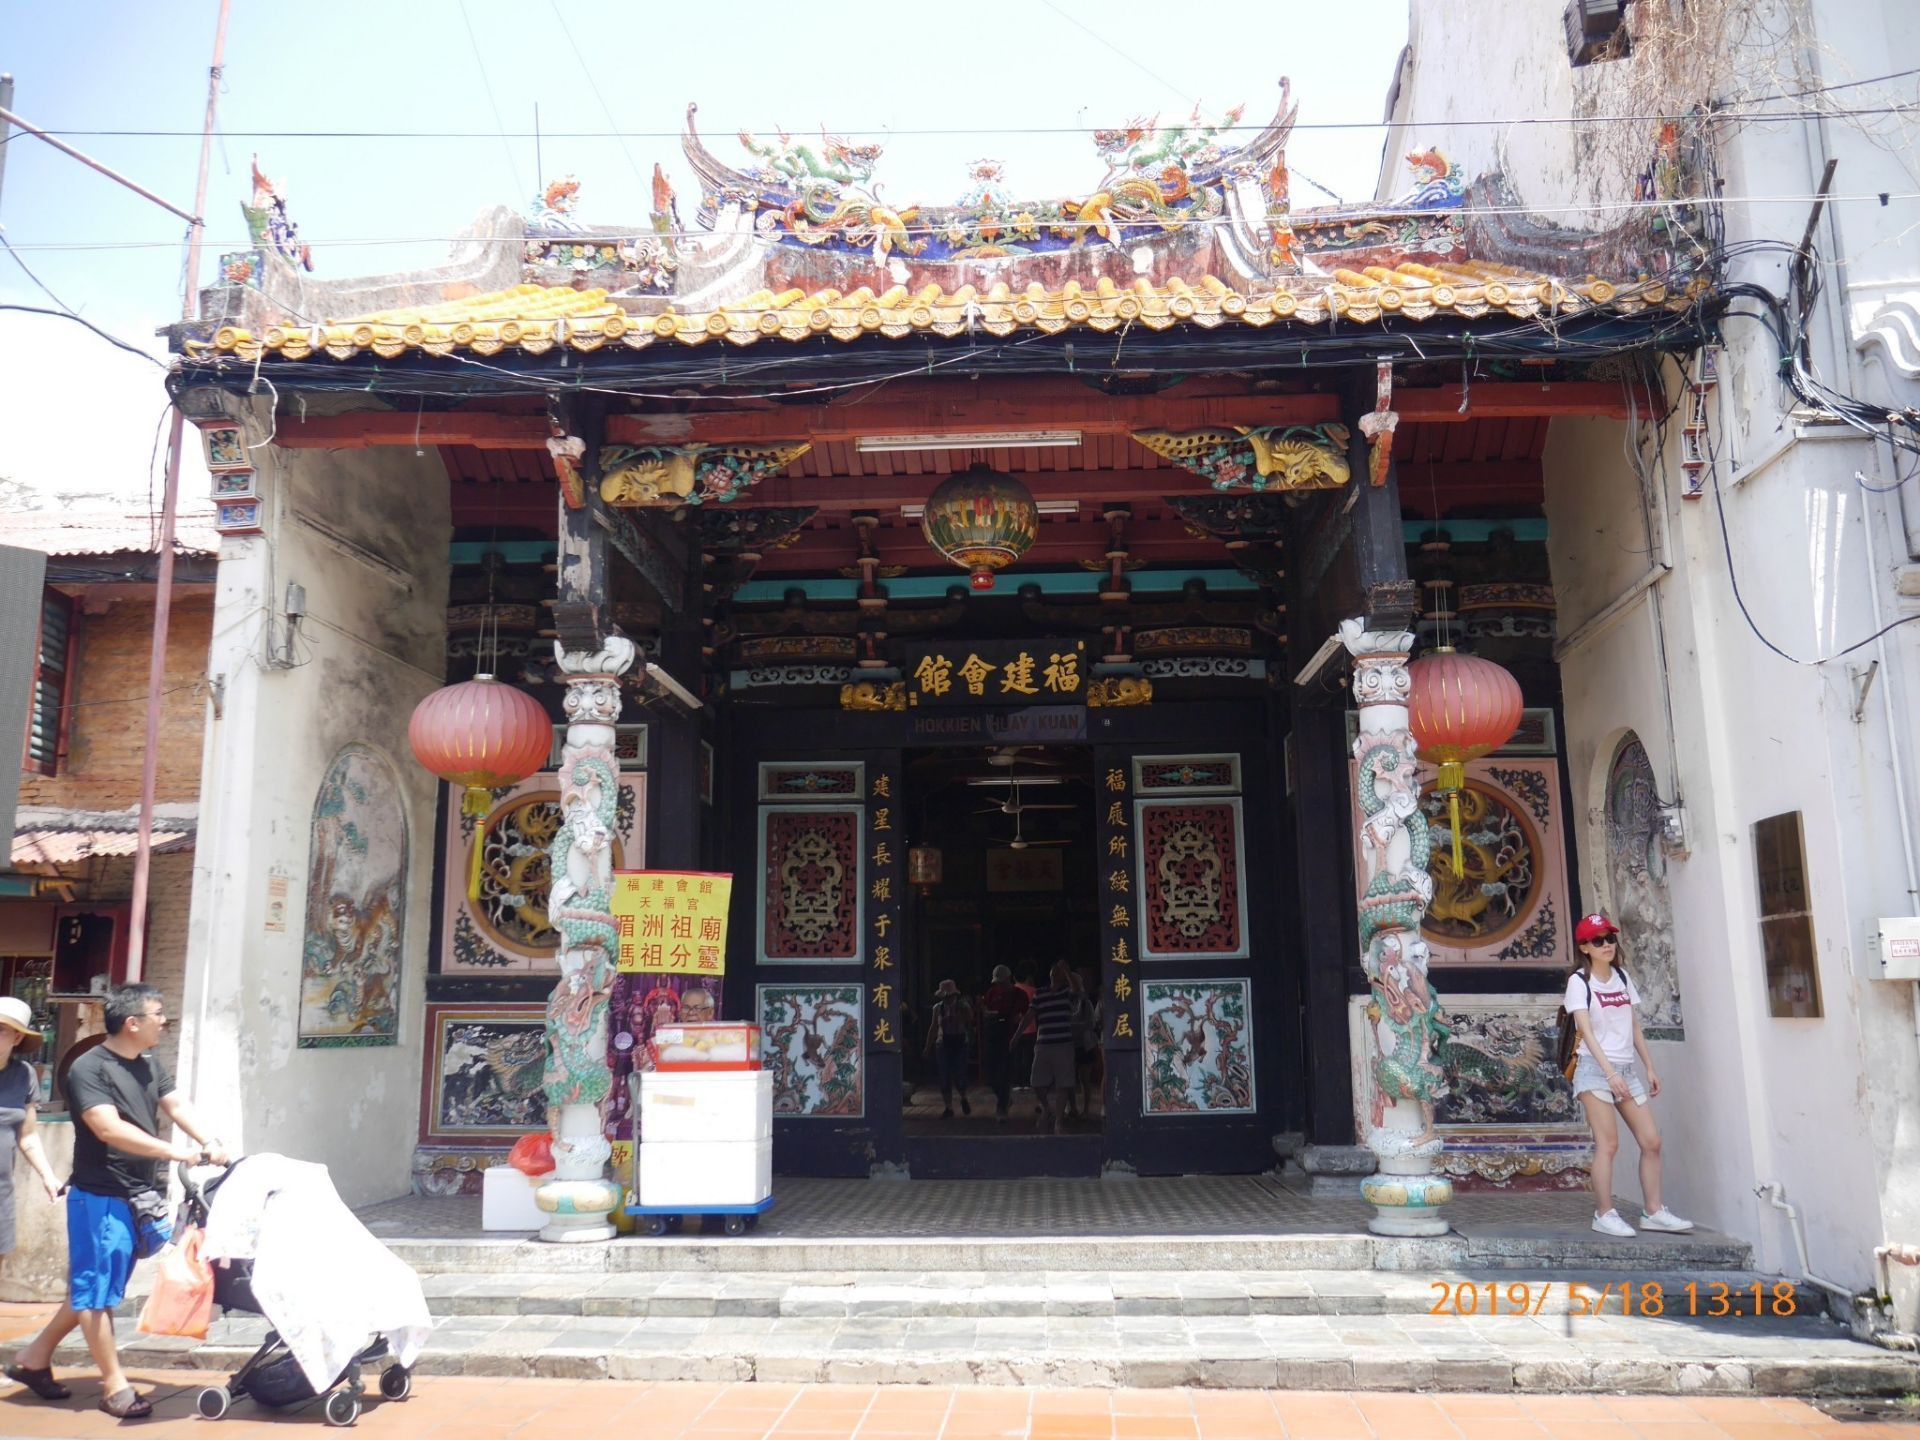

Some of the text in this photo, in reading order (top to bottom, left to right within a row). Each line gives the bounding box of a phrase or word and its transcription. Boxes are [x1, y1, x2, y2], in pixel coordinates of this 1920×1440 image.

[914, 716, 982, 734] HOKKIEN
[1038, 714, 1080, 730] KUAN
[626, 877, 713, 895] 福建會館
[639, 896, 700, 912] 天福宮
[614, 913, 723, 942] 湄洲祖廟
